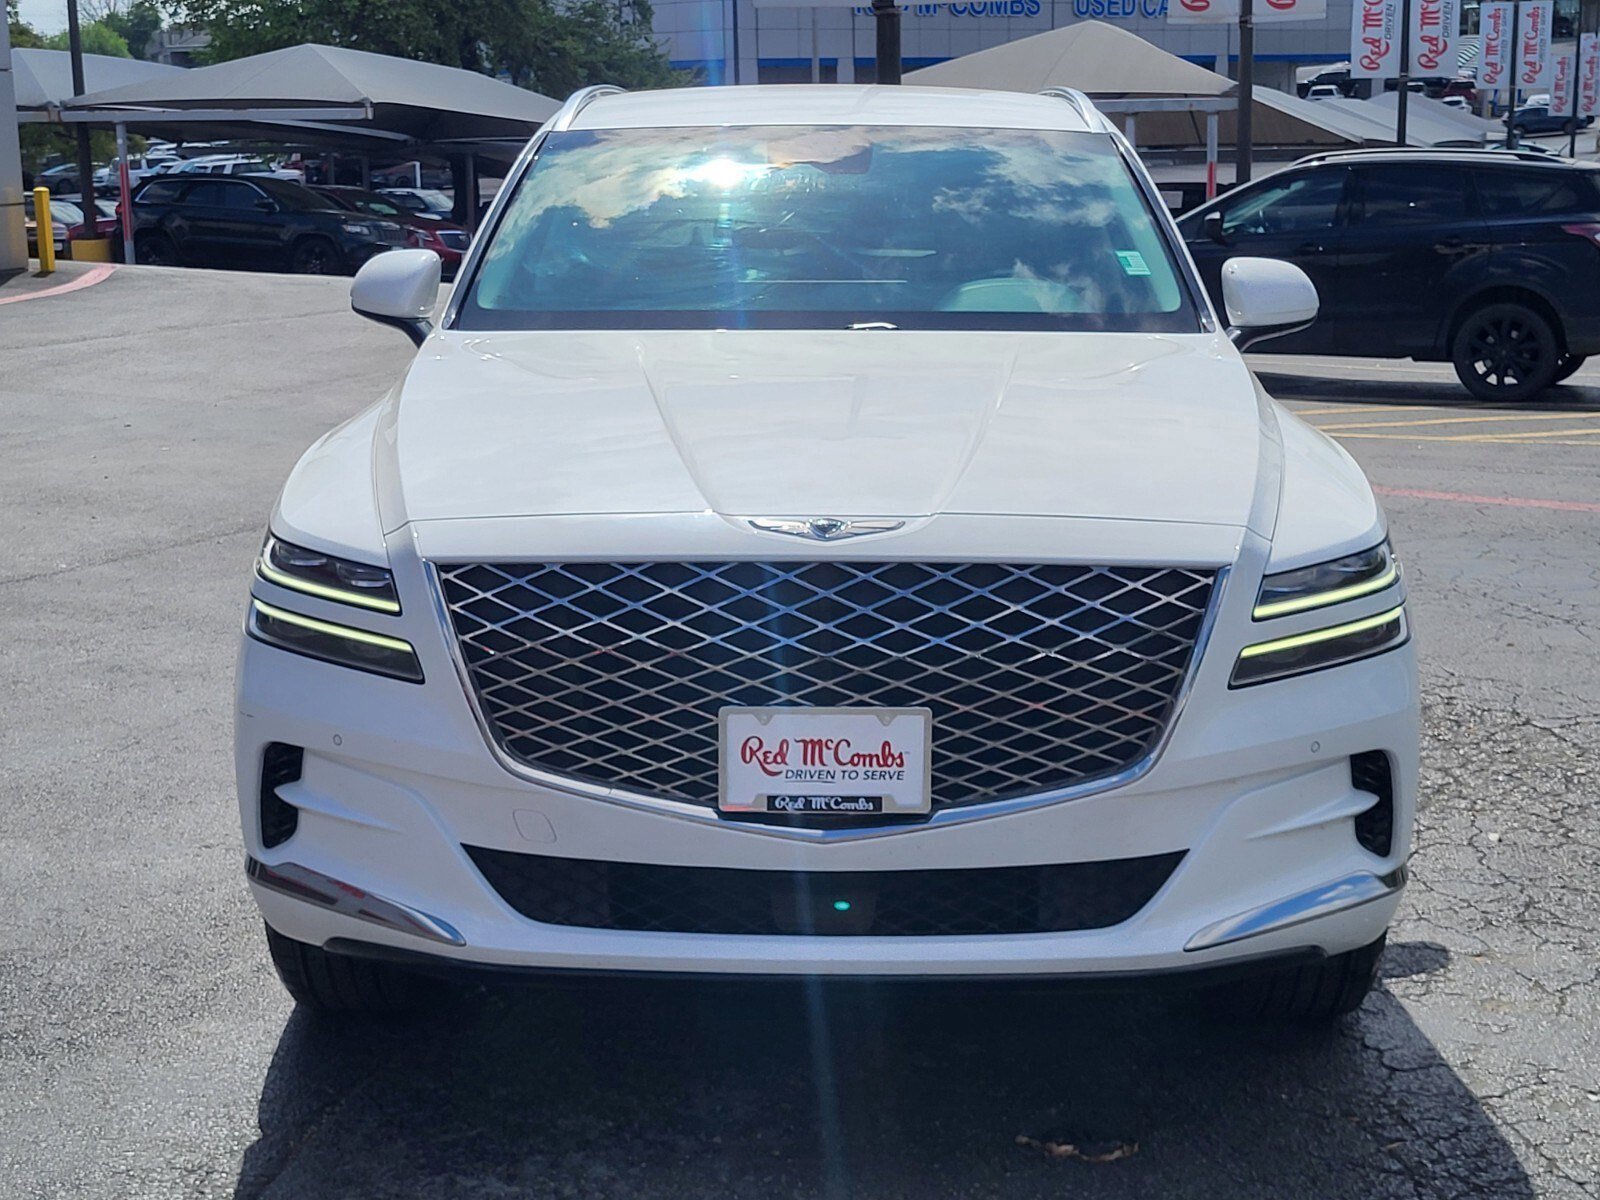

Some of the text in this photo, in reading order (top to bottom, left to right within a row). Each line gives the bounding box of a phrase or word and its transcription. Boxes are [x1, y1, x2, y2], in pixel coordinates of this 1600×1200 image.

[1074, 0, 1138, 17] USED
[1384, 3, 1393, 40] DRIVEN
[1359, 36, 1390, 71] Red
[1417, 34, 1448, 70] Red
[1482, 61, 1504, 85] Red
[1521, 60, 1543, 84] Red
[741, 735, 905, 777] Red McCombs
[785, 769, 905, 781] DRIVEN TO SERVE
[774, 796, 874, 812] Red McCombs
